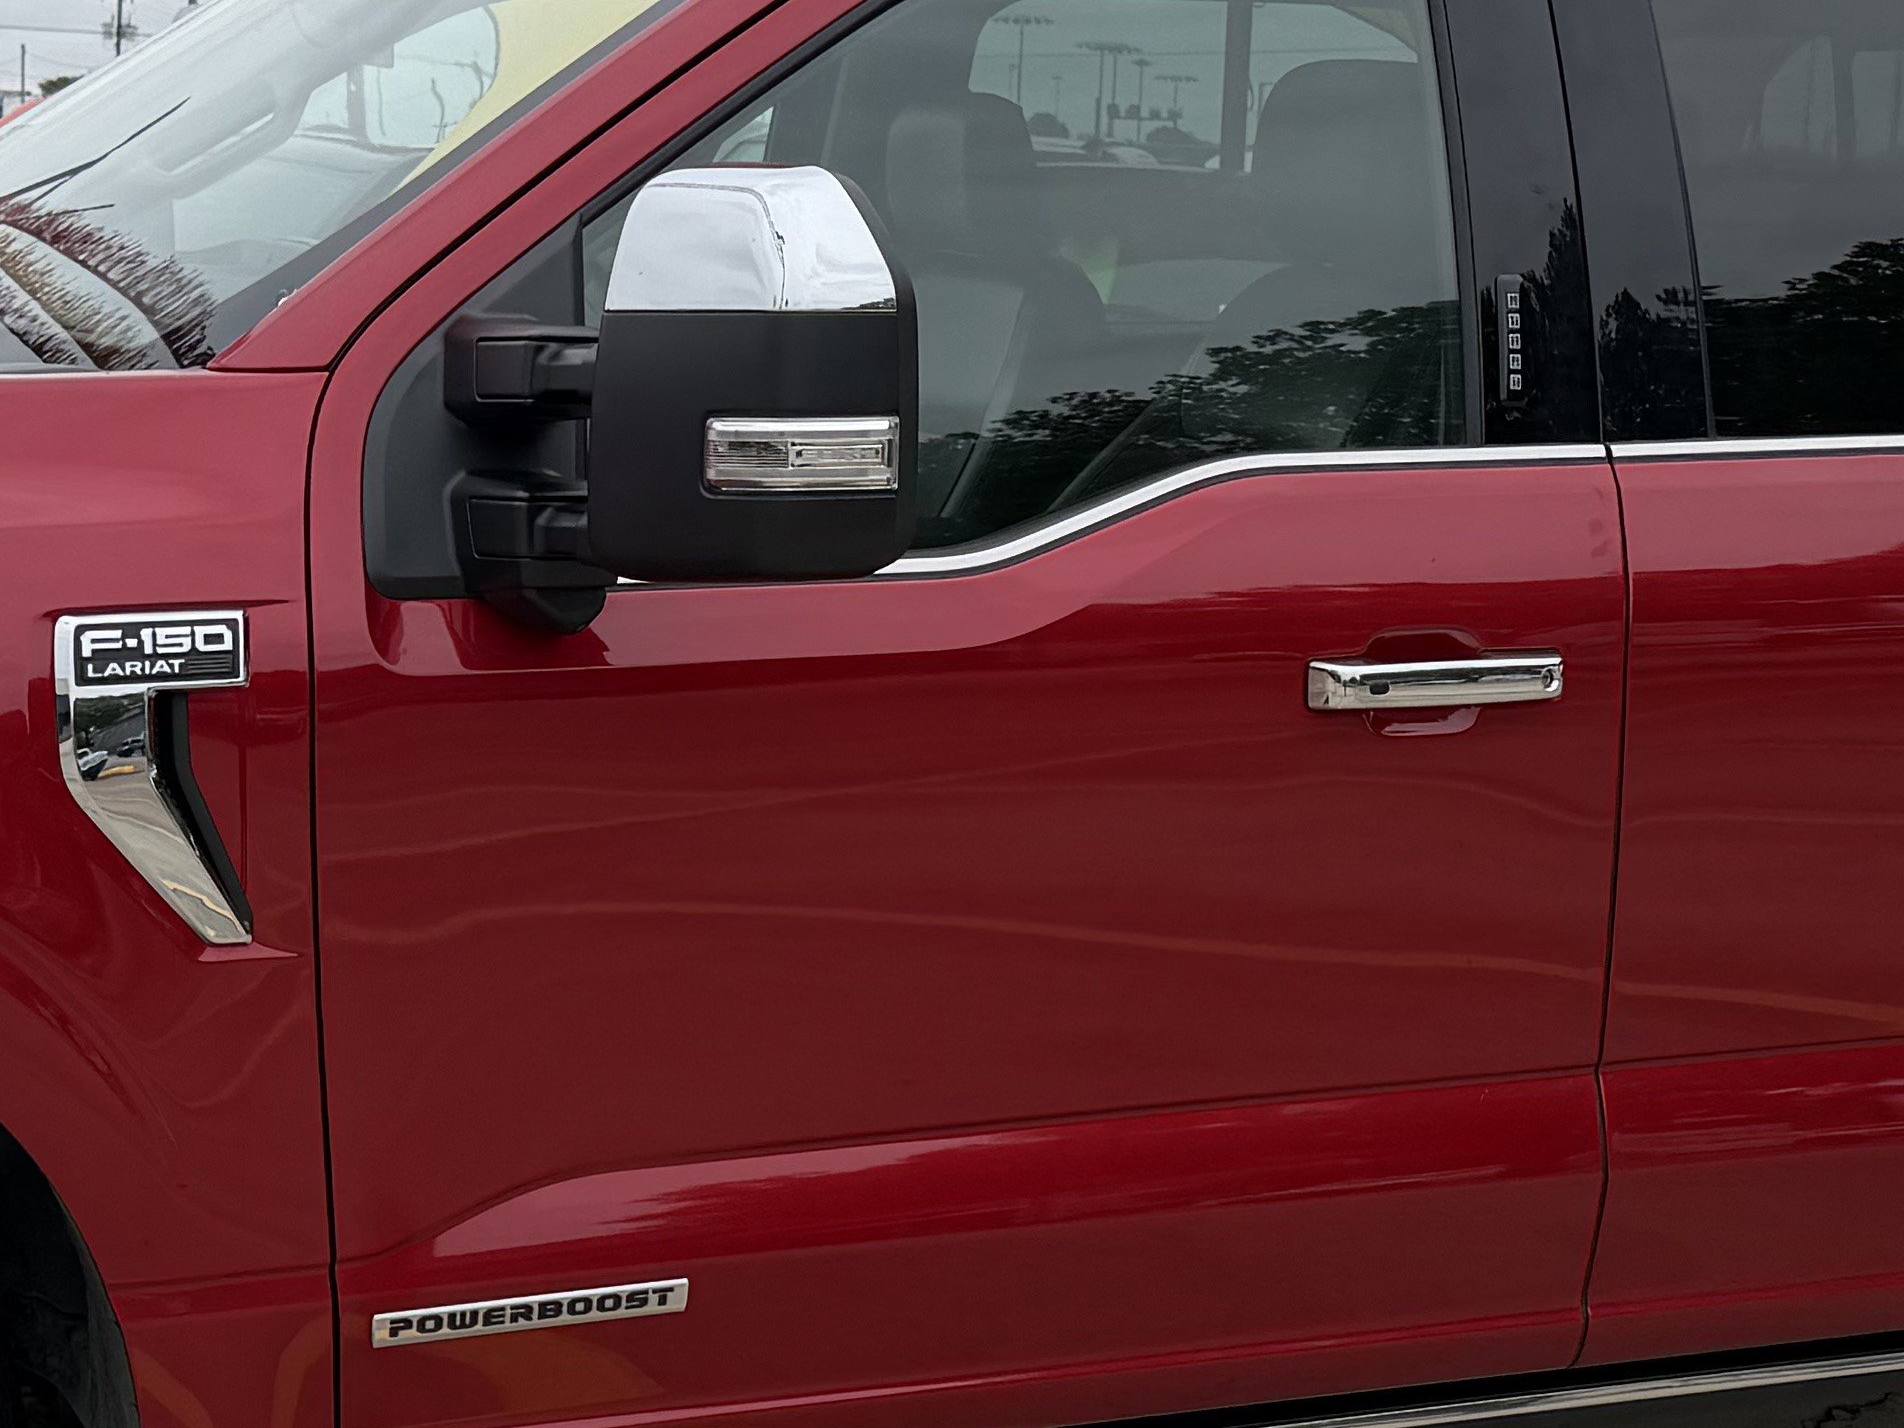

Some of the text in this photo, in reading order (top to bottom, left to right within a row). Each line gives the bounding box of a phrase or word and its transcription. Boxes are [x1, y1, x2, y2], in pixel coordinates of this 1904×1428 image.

[79, 624, 234, 658] F-150
[87, 659, 185, 678] LARIAT
[388, 1287, 675, 1338] POWERBOOST
